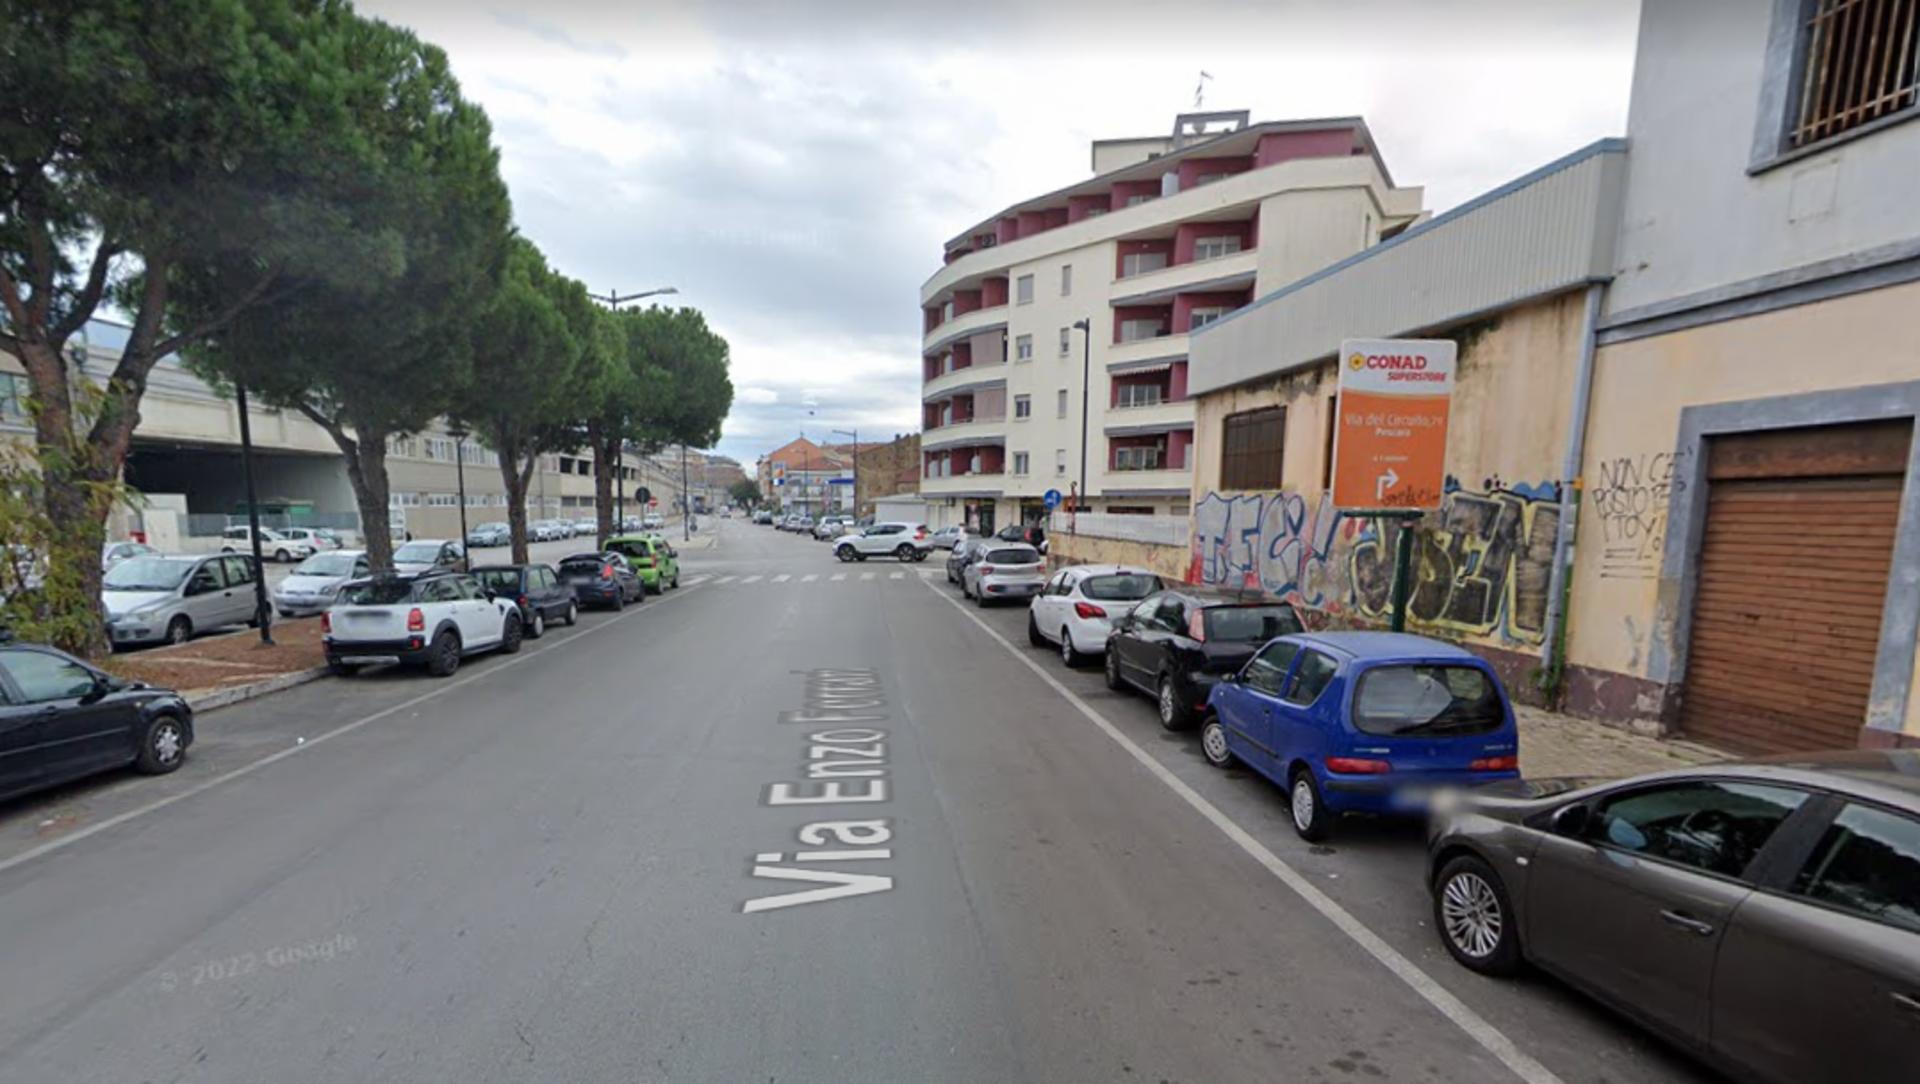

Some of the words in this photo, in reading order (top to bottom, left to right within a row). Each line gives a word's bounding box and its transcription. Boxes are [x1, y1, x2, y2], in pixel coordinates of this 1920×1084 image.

[1366, 355, 1427, 370] CONAD
[1386, 371, 1448, 383] SUPERSTORE
[1345, 413, 1363, 426] Via
[1366, 412, 1385, 426] del
